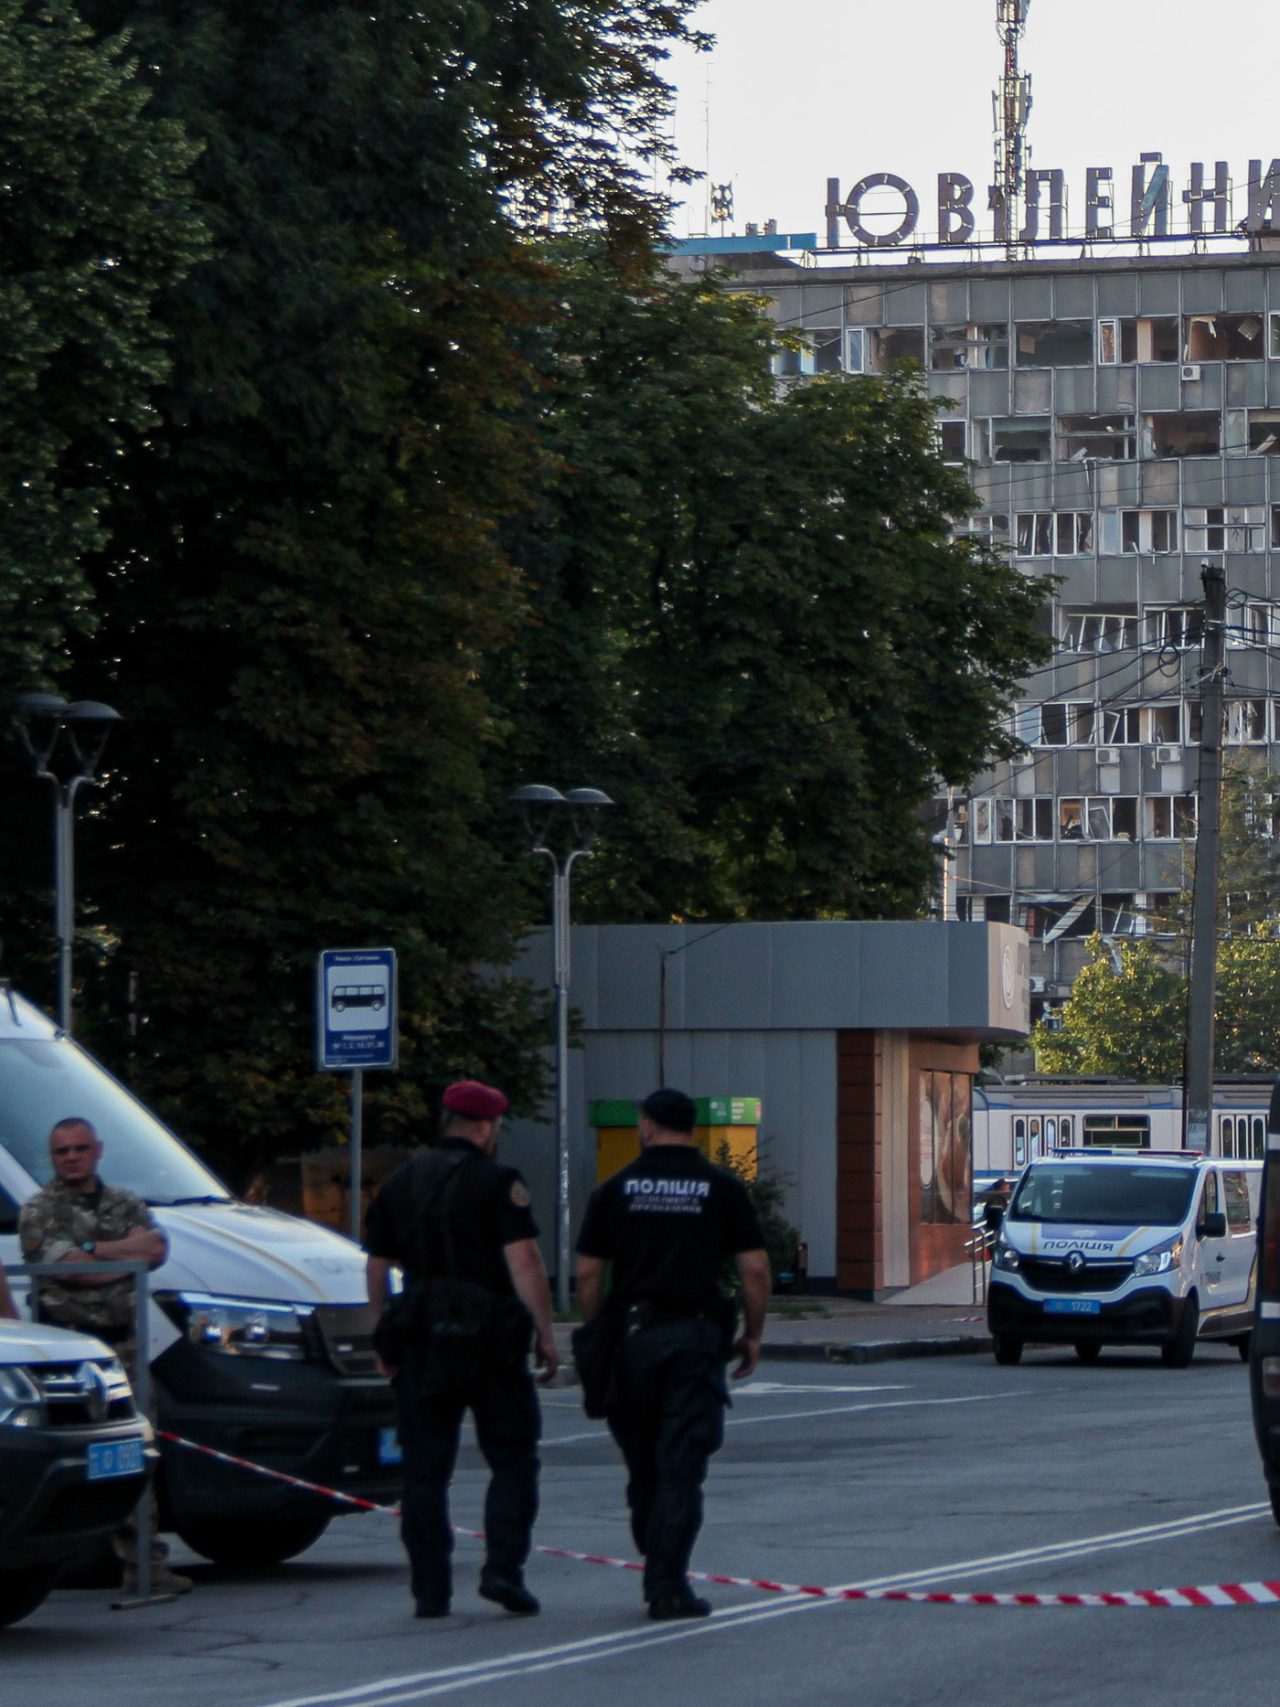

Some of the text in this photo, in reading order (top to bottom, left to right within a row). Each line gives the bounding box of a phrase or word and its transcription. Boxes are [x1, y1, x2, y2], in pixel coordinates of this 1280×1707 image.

[624, 1178, 711, 1196] ПОЛІЦІЯ
[1043, 1240, 1114, 1252] ПОЛІЦІЯ
[1072, 1301, 1093, 1312] 1722
